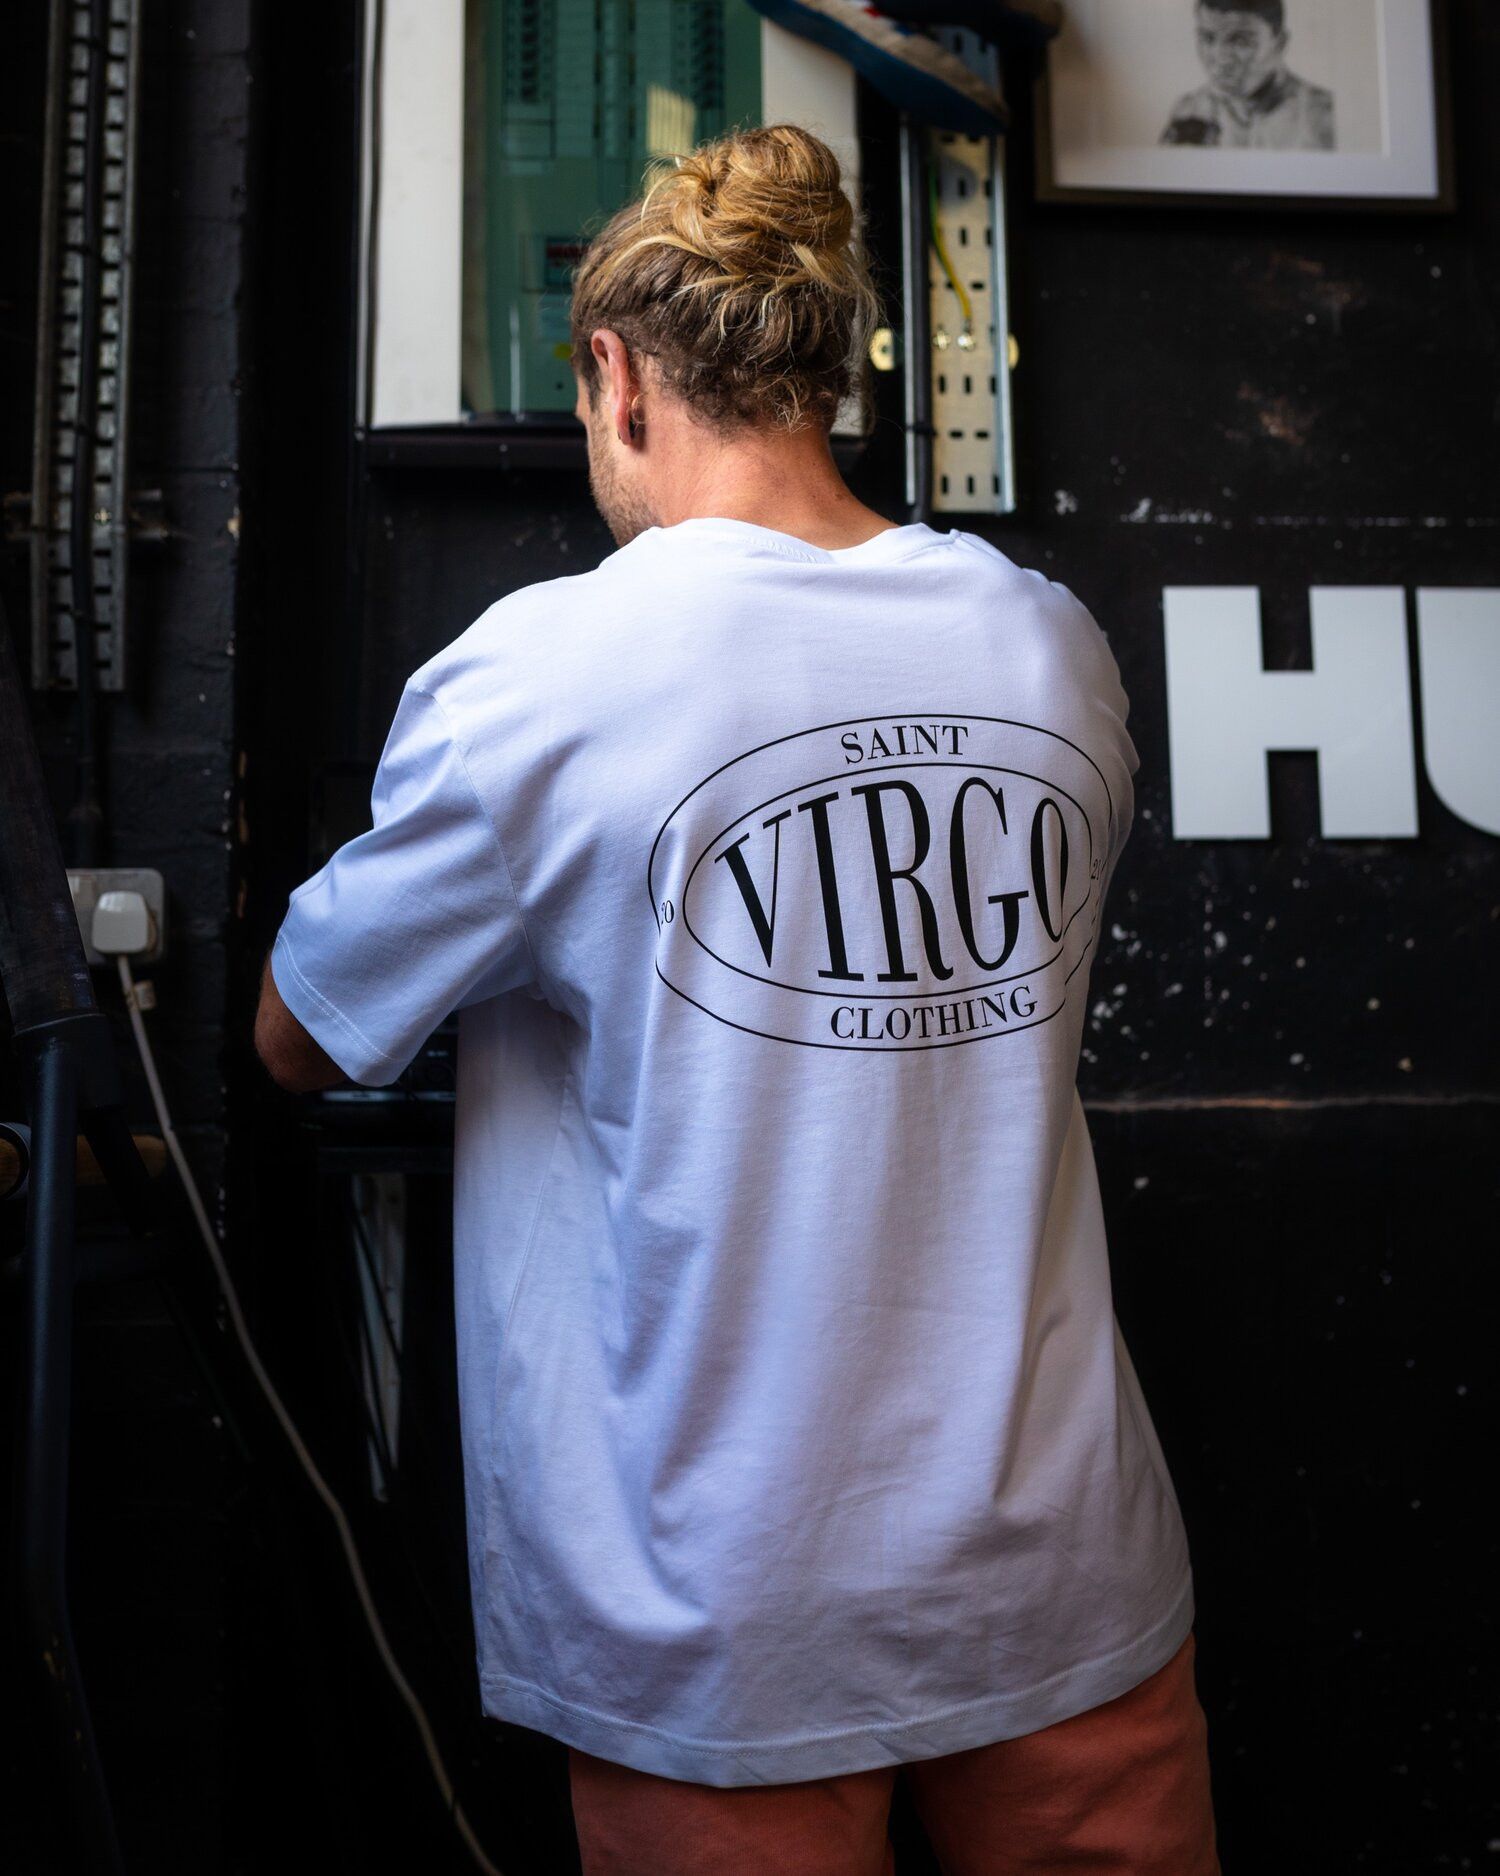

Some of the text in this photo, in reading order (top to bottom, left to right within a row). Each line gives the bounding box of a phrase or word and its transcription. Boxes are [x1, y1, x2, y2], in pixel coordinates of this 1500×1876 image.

[840, 724, 969, 765] SAINT
[714, 776, 1070, 983] VIRGO
[829, 985, 1039, 1041] CLOTHING
